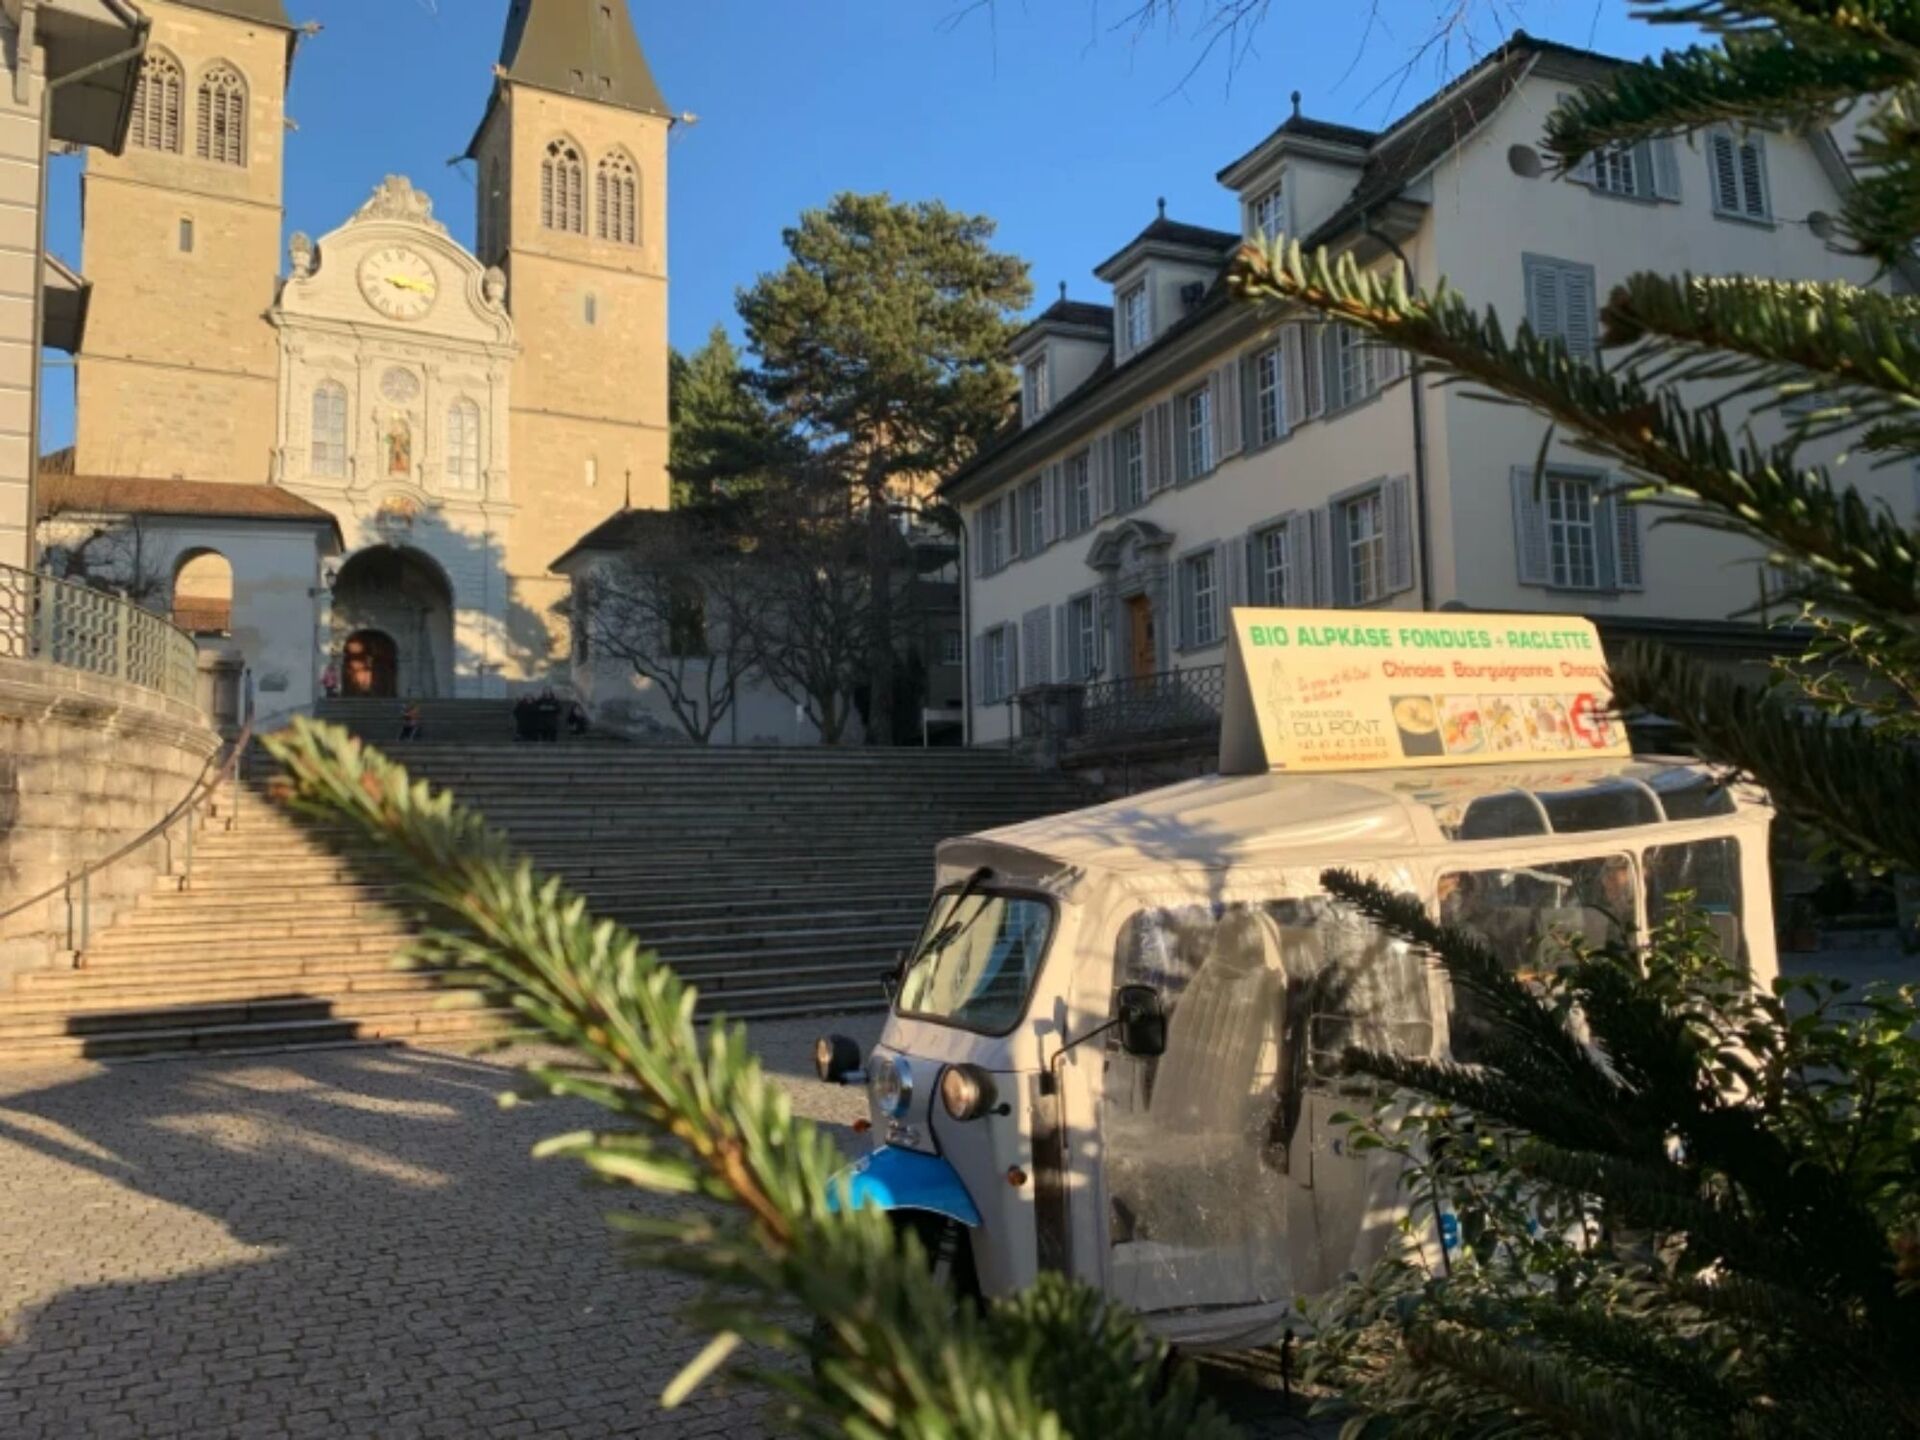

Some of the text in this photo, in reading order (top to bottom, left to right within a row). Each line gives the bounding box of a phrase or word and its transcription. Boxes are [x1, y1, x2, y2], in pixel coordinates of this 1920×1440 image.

[1249, 625, 1290, 647] BIO
[1297, 624, 1393, 648] ALPKÄSE
[1398, 627, 1492, 649] FONDUES
[1506, 630, 1593, 650] RACLETTE
[1381, 660, 1445, 679] Chinoise
[1452, 660, 1555, 682] Bourguignonne
[1293, 719, 1381, 738] DU PONT
